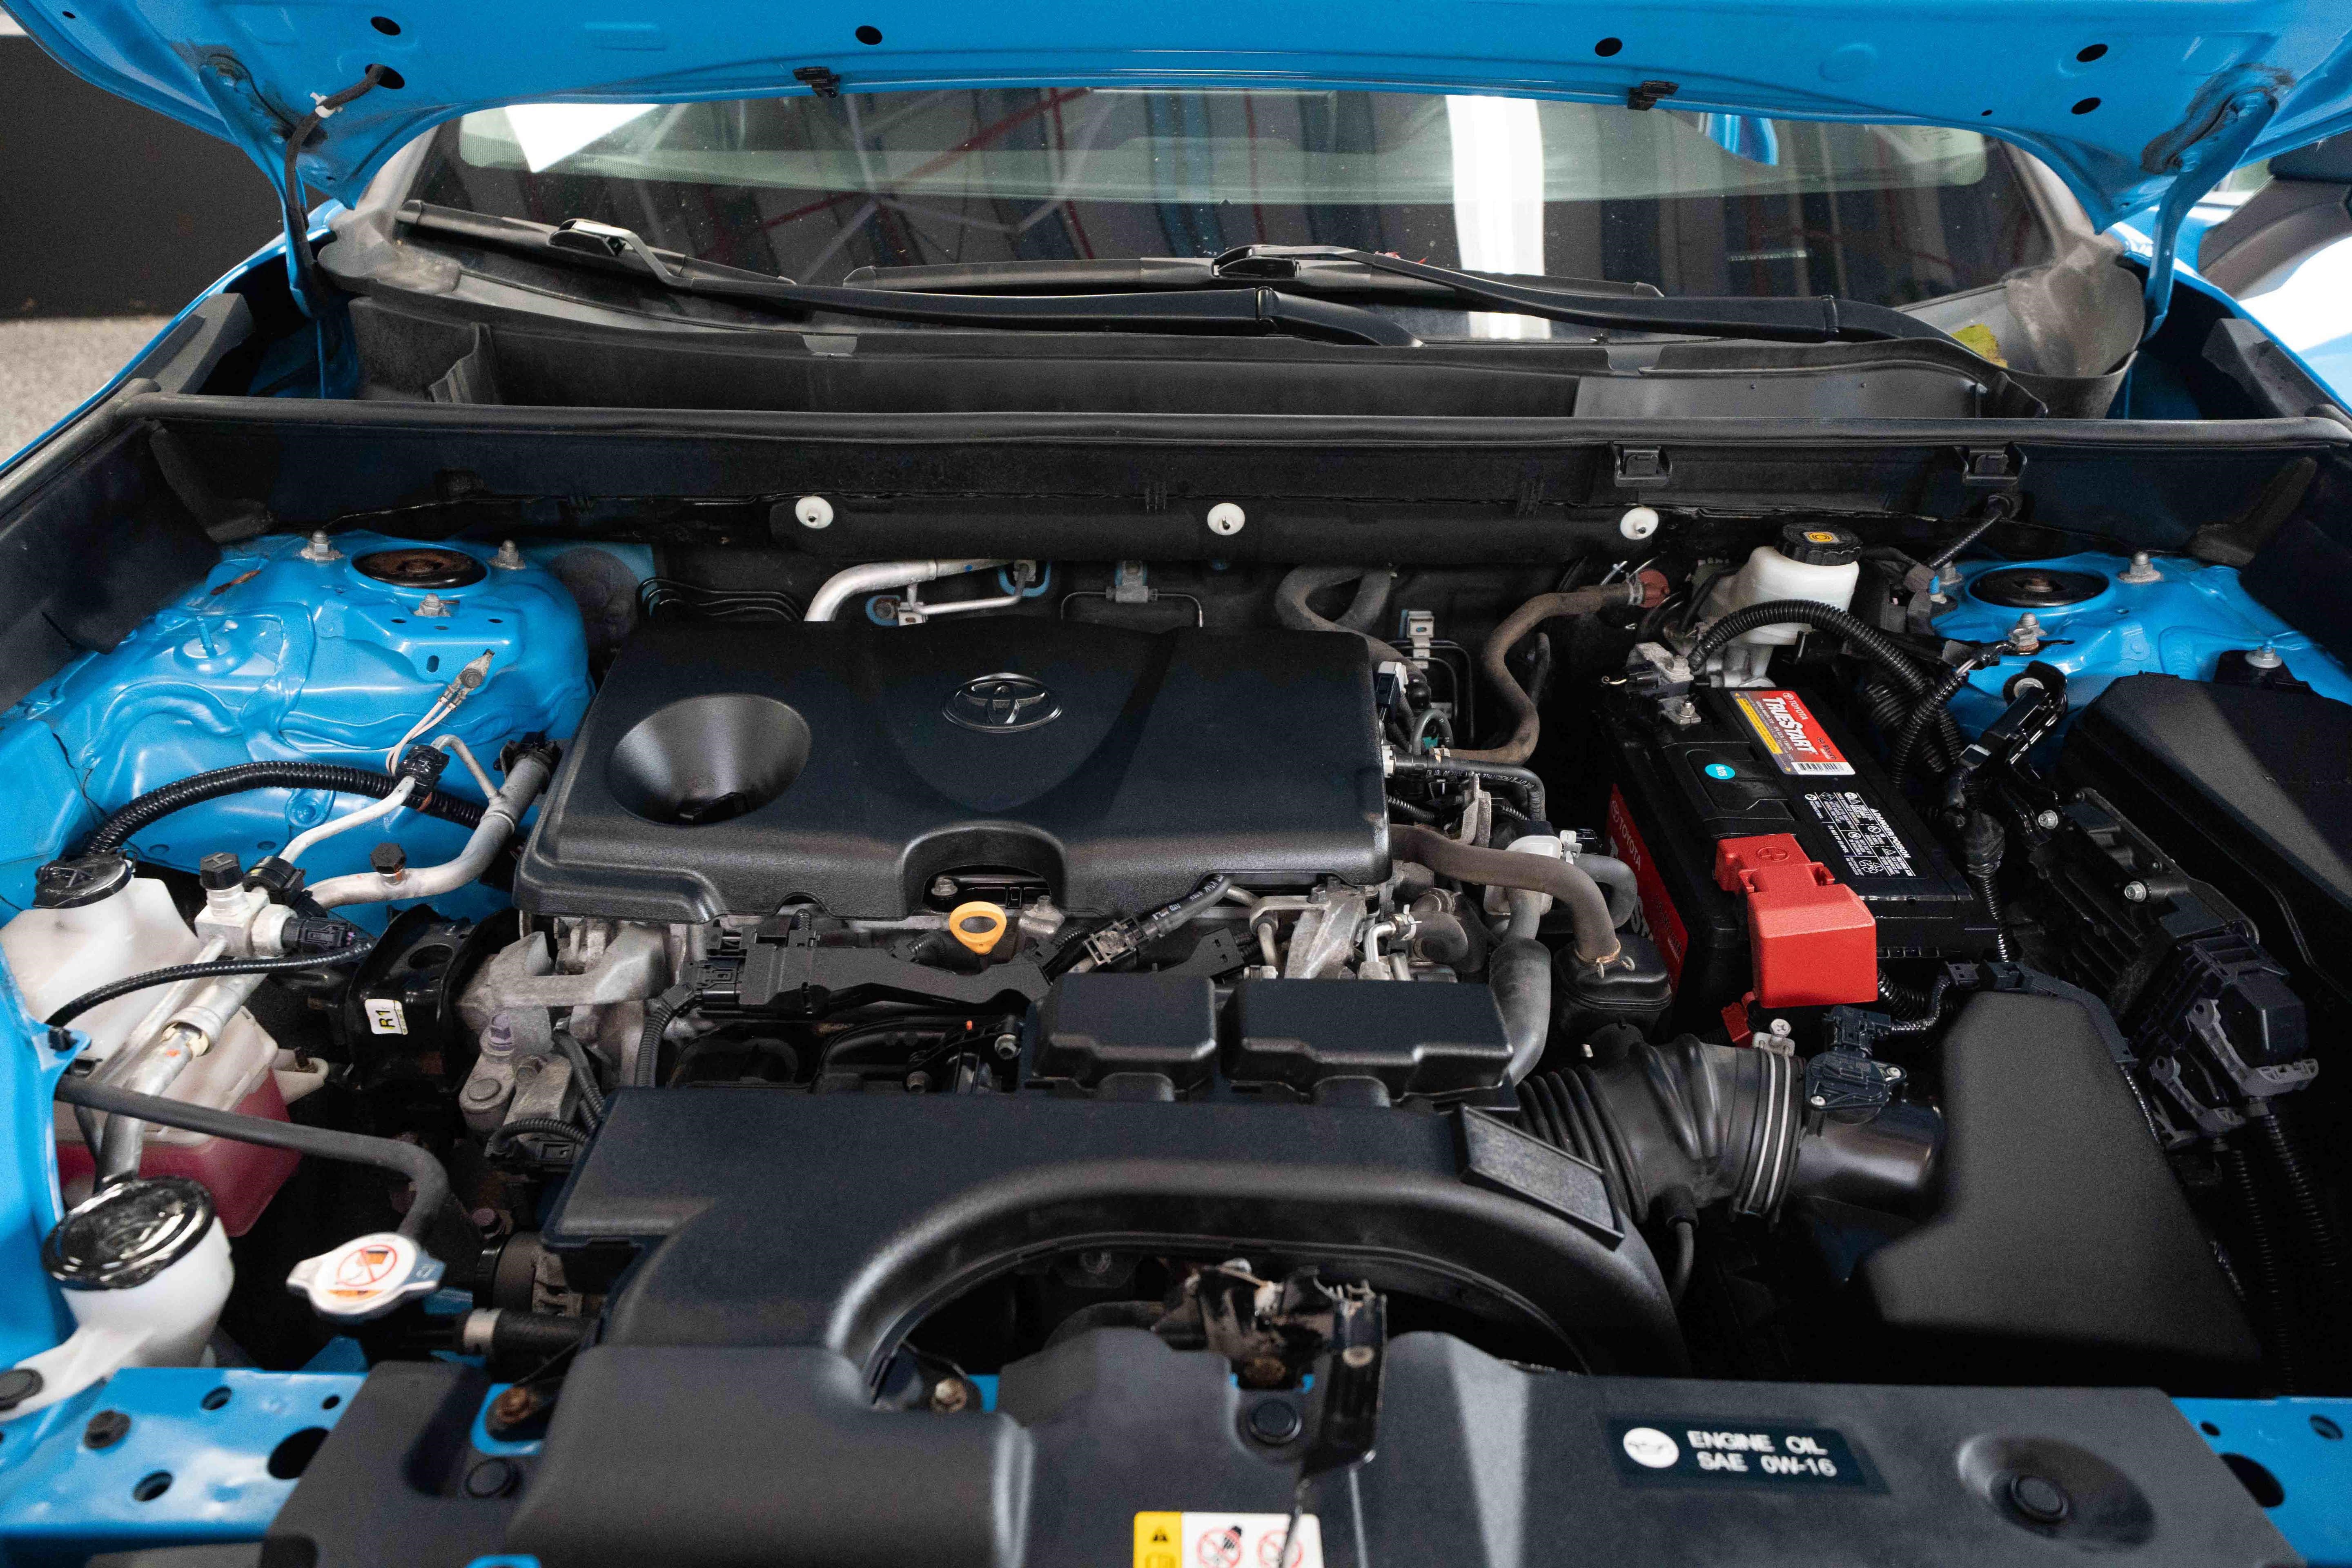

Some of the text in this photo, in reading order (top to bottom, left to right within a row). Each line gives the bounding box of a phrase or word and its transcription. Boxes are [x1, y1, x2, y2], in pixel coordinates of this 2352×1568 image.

[1789, 700, 1809, 719] TOYOTA
[1762, 697, 1818, 754] TRUESTART
[1619, 817, 1640, 871] TOYOTA
[1873, 813, 1911, 858] DANGER/POISON
[375, 1010, 395, 1027] R1
[1687, 1430, 1828, 1456] ENGINE OIL
[1697, 1451, 1838, 1477] SAE 0W-16
